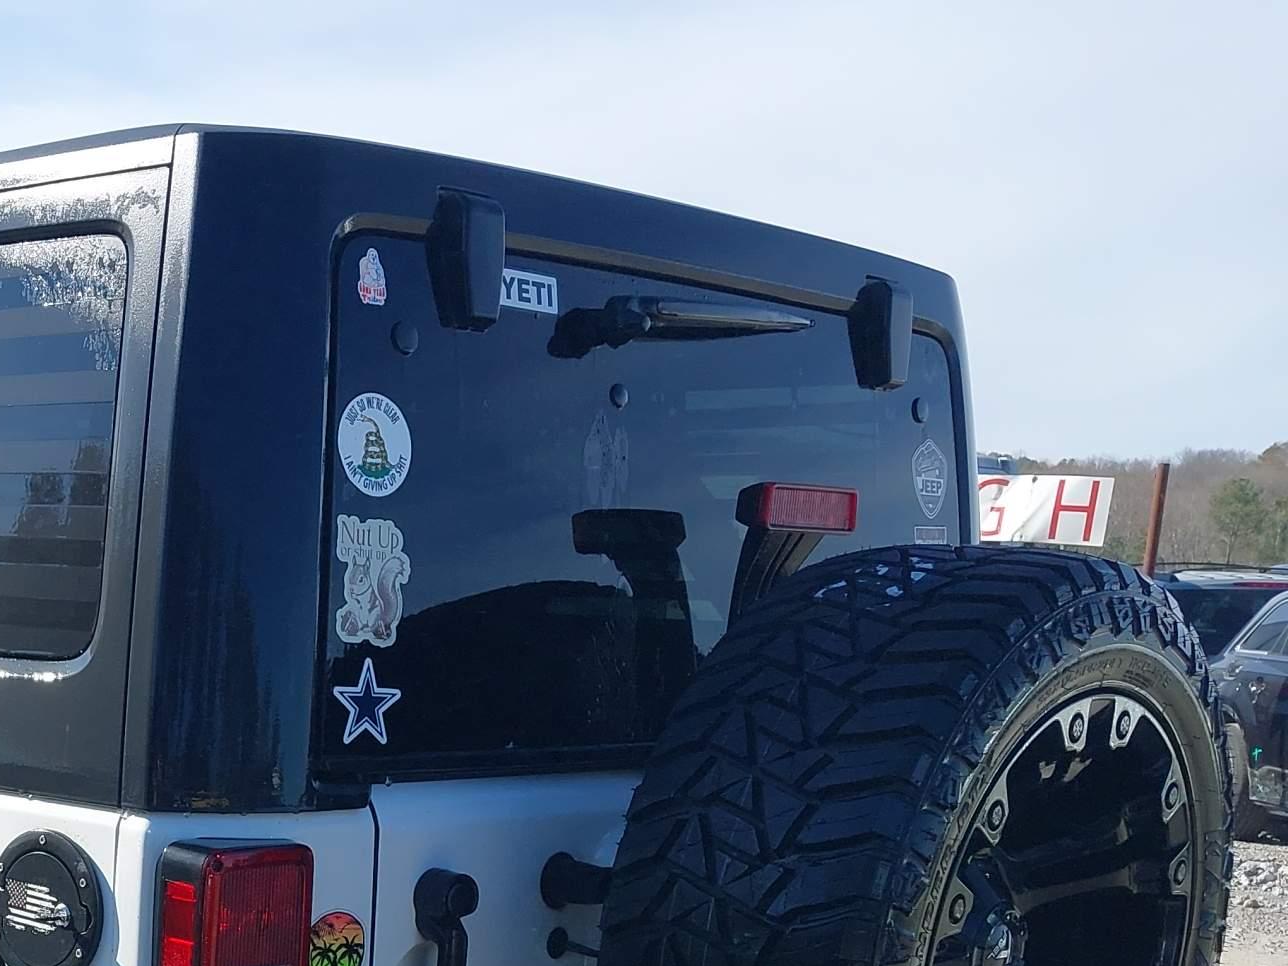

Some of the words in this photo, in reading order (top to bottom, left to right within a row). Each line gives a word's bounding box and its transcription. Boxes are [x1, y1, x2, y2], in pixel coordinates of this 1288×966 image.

[502, 274, 553, 307] YETI
[345, 404, 359, 425] JUST
[356, 398, 366, 412] SO
[383, 402, 400, 425] CLEAR
[345, 461, 364, 483] AIN'T
[363, 478, 388, 492] GIVING
[387, 473, 398, 487] UP
[396, 454, 408, 478] SHIT
[920, 479, 942, 494] JEEP
[341, 520, 372, 547] Nut
[378, 525, 399, 554] Up
[341, 547, 352, 557] or
[354, 546, 373, 560] shut
[376, 550, 387, 562] up
